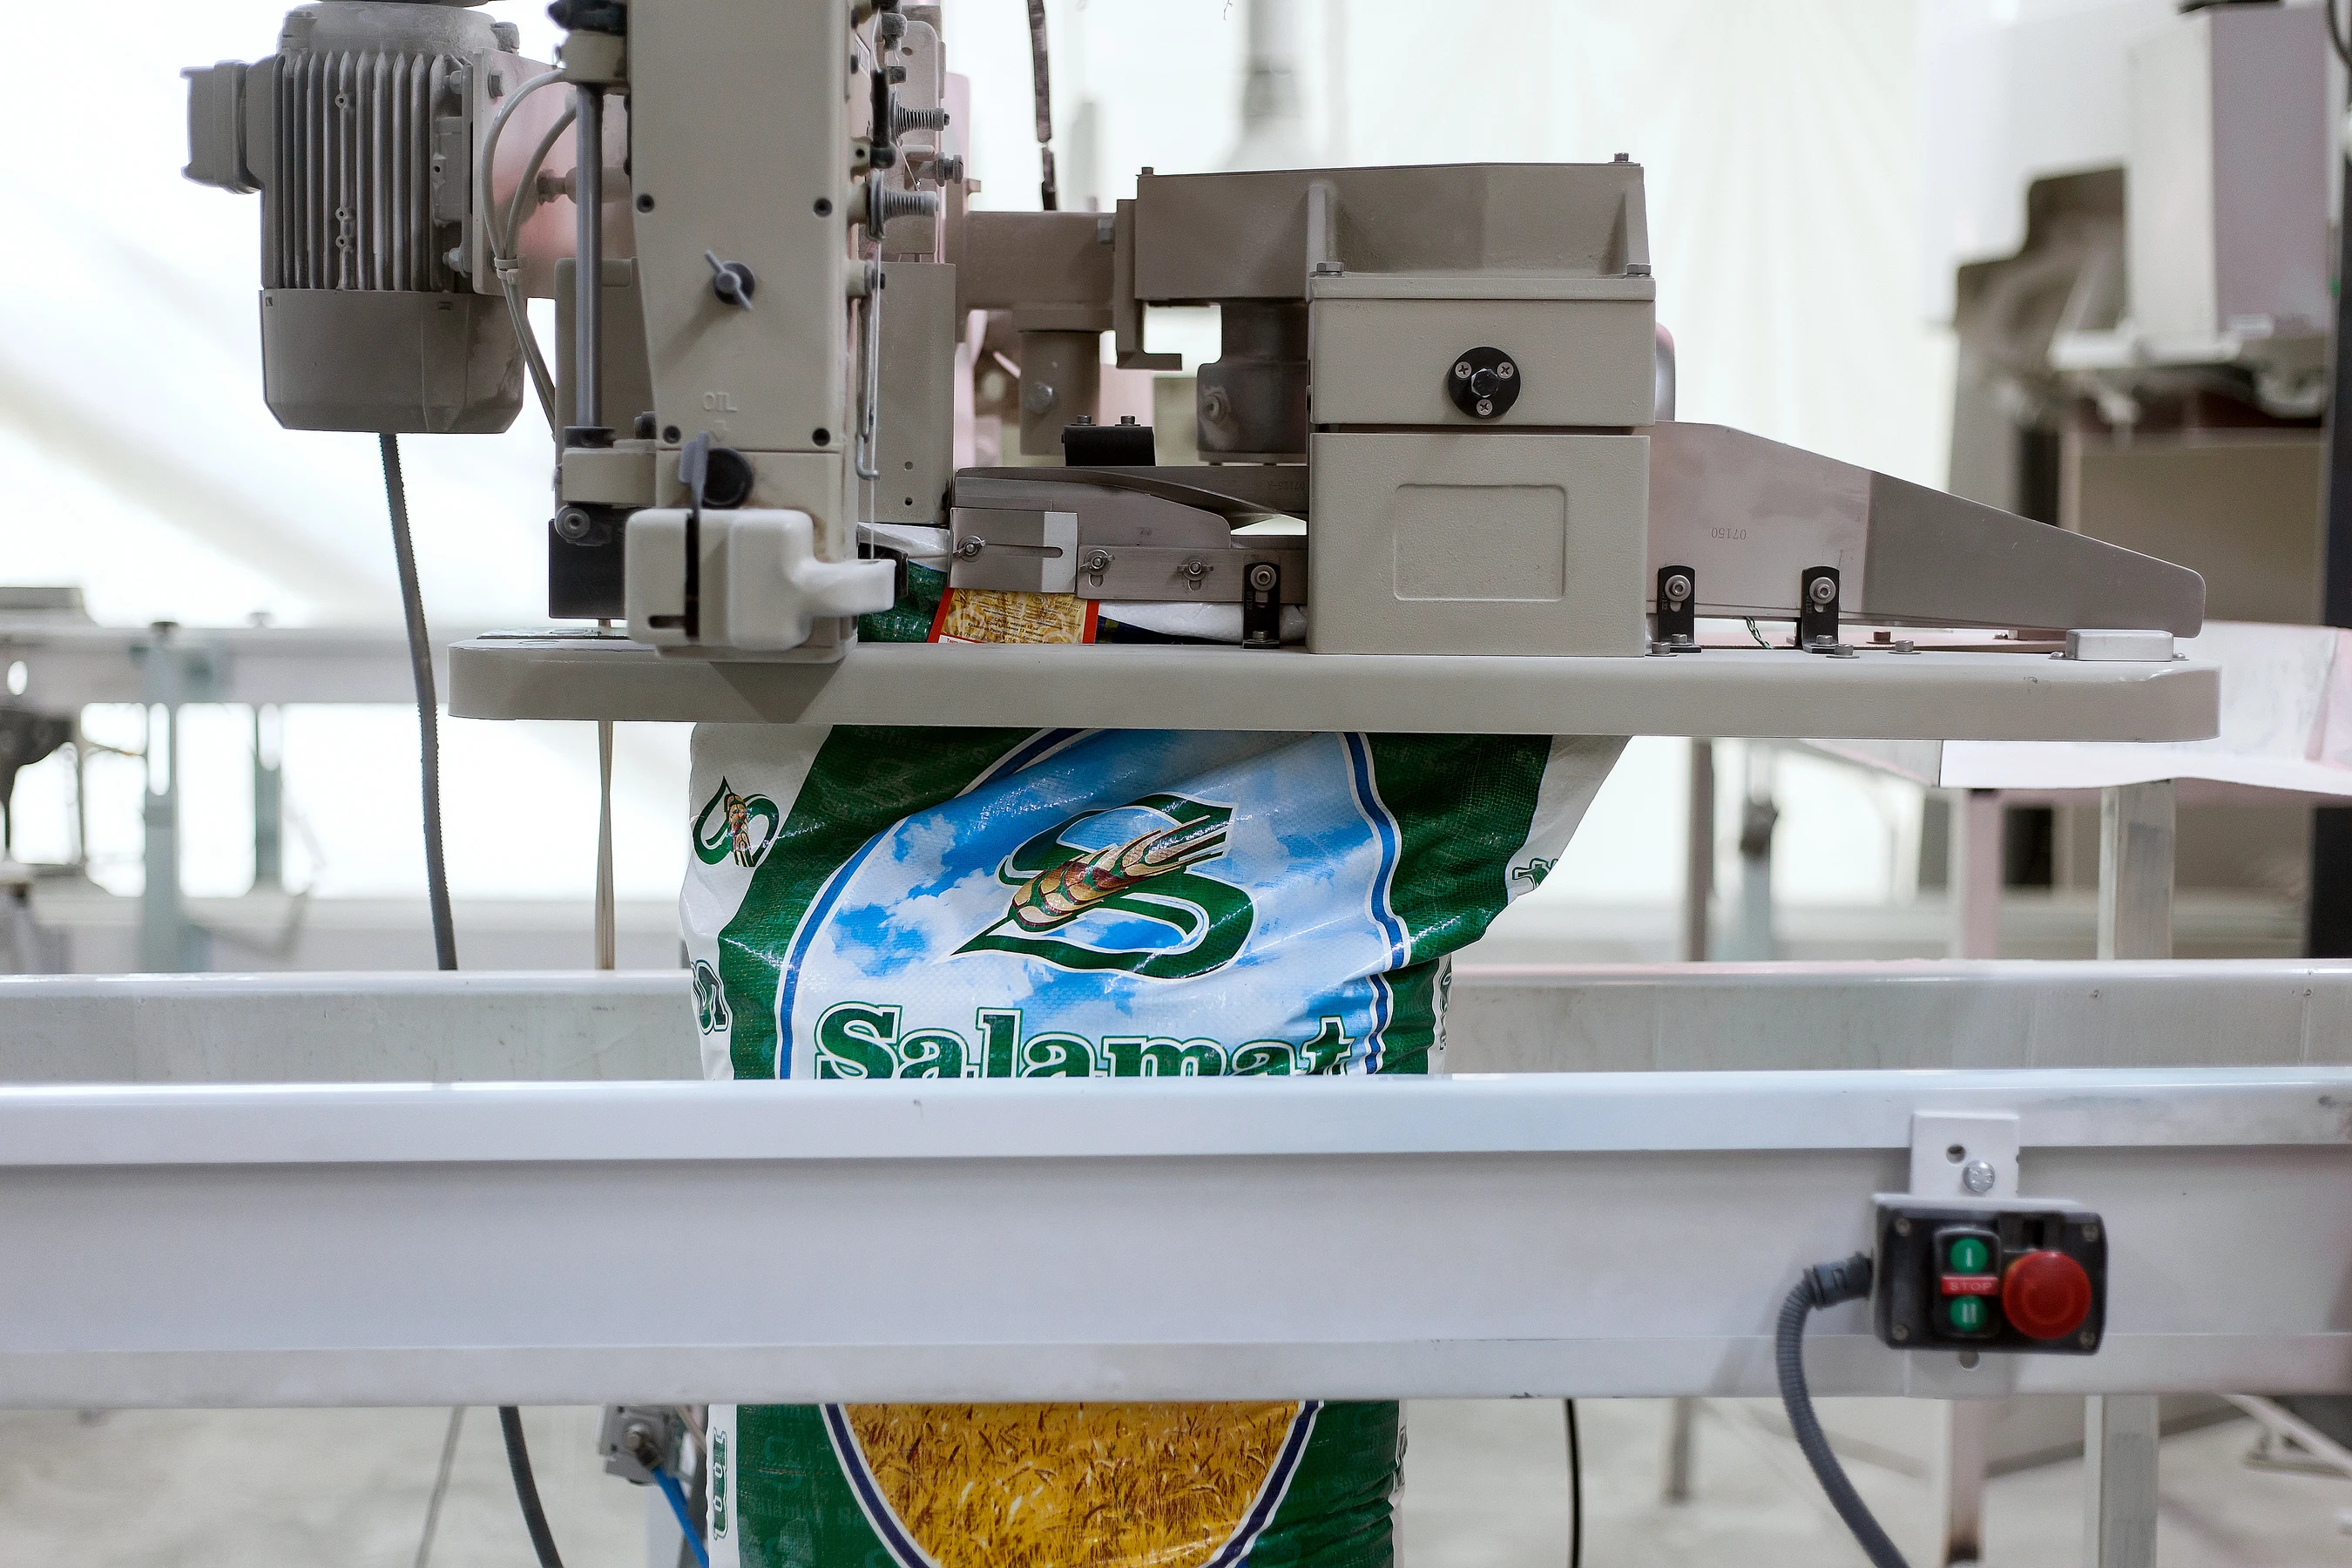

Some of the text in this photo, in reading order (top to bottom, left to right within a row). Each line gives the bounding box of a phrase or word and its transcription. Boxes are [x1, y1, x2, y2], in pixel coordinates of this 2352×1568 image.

[702, 391, 738, 412] OIL
[1711, 527, 1747, 540] 07150
[814, 1000, 1356, 1080] Salamat
[1950, 1282, 1992, 1291] STOP
